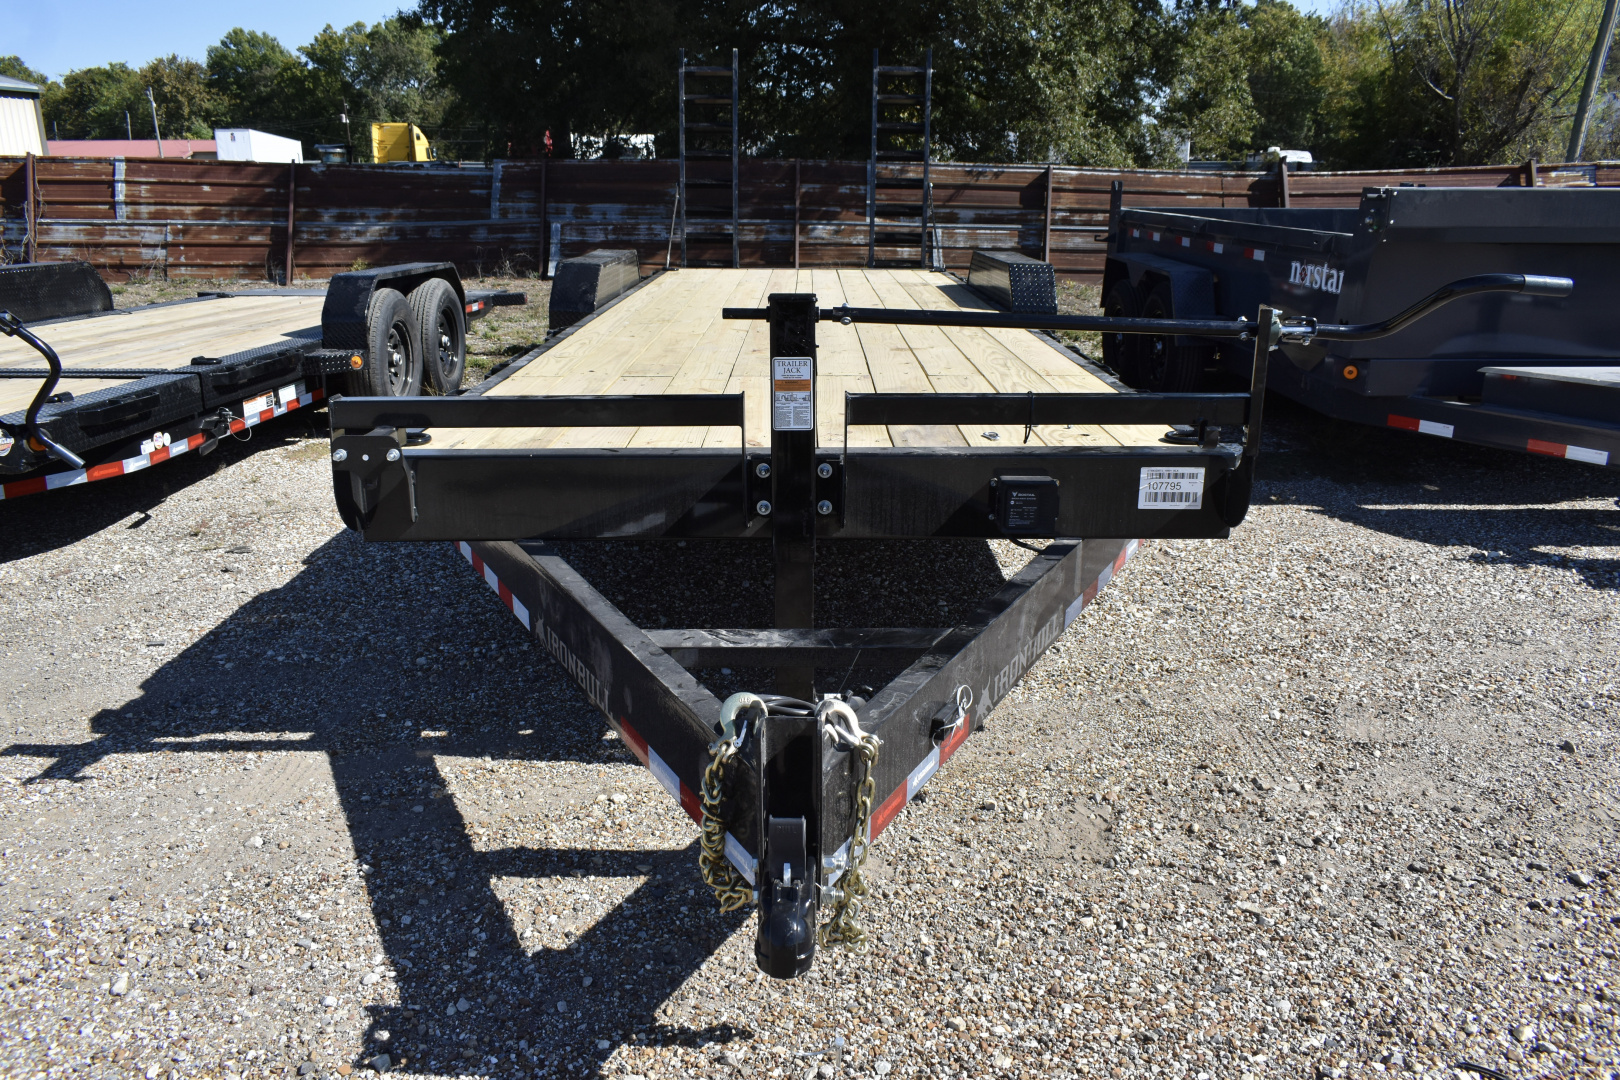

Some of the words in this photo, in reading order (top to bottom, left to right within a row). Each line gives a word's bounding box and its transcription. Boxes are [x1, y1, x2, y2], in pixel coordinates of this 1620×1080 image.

[1147, 481, 1182, 490] 107795
[546, 626, 613, 719] IRONBULL
[993, 613, 1059, 703] IRONBULL
